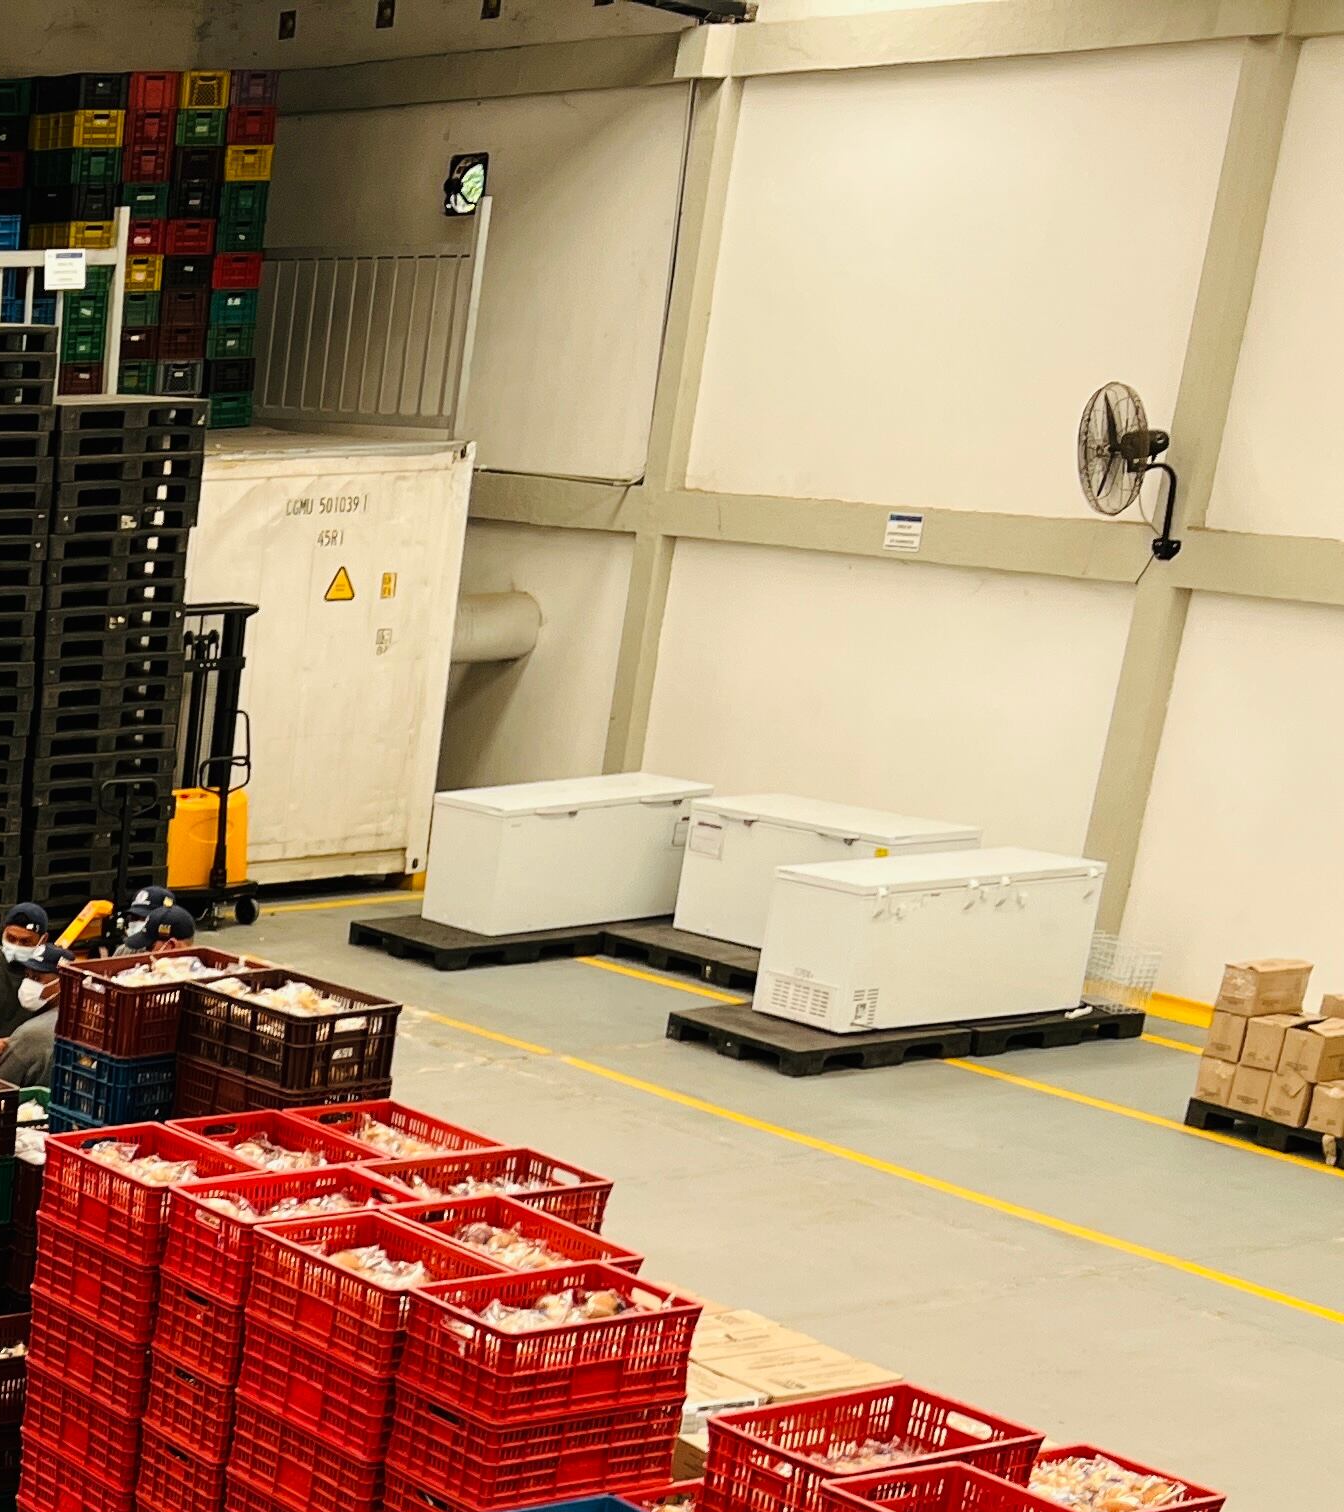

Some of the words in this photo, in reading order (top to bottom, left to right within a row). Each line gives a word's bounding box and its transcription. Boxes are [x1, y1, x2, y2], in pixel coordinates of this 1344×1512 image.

[286, 498, 313, 516] CGMU
[319, 495, 360, 514] 501039
[317, 530, 344, 547] 45R1
